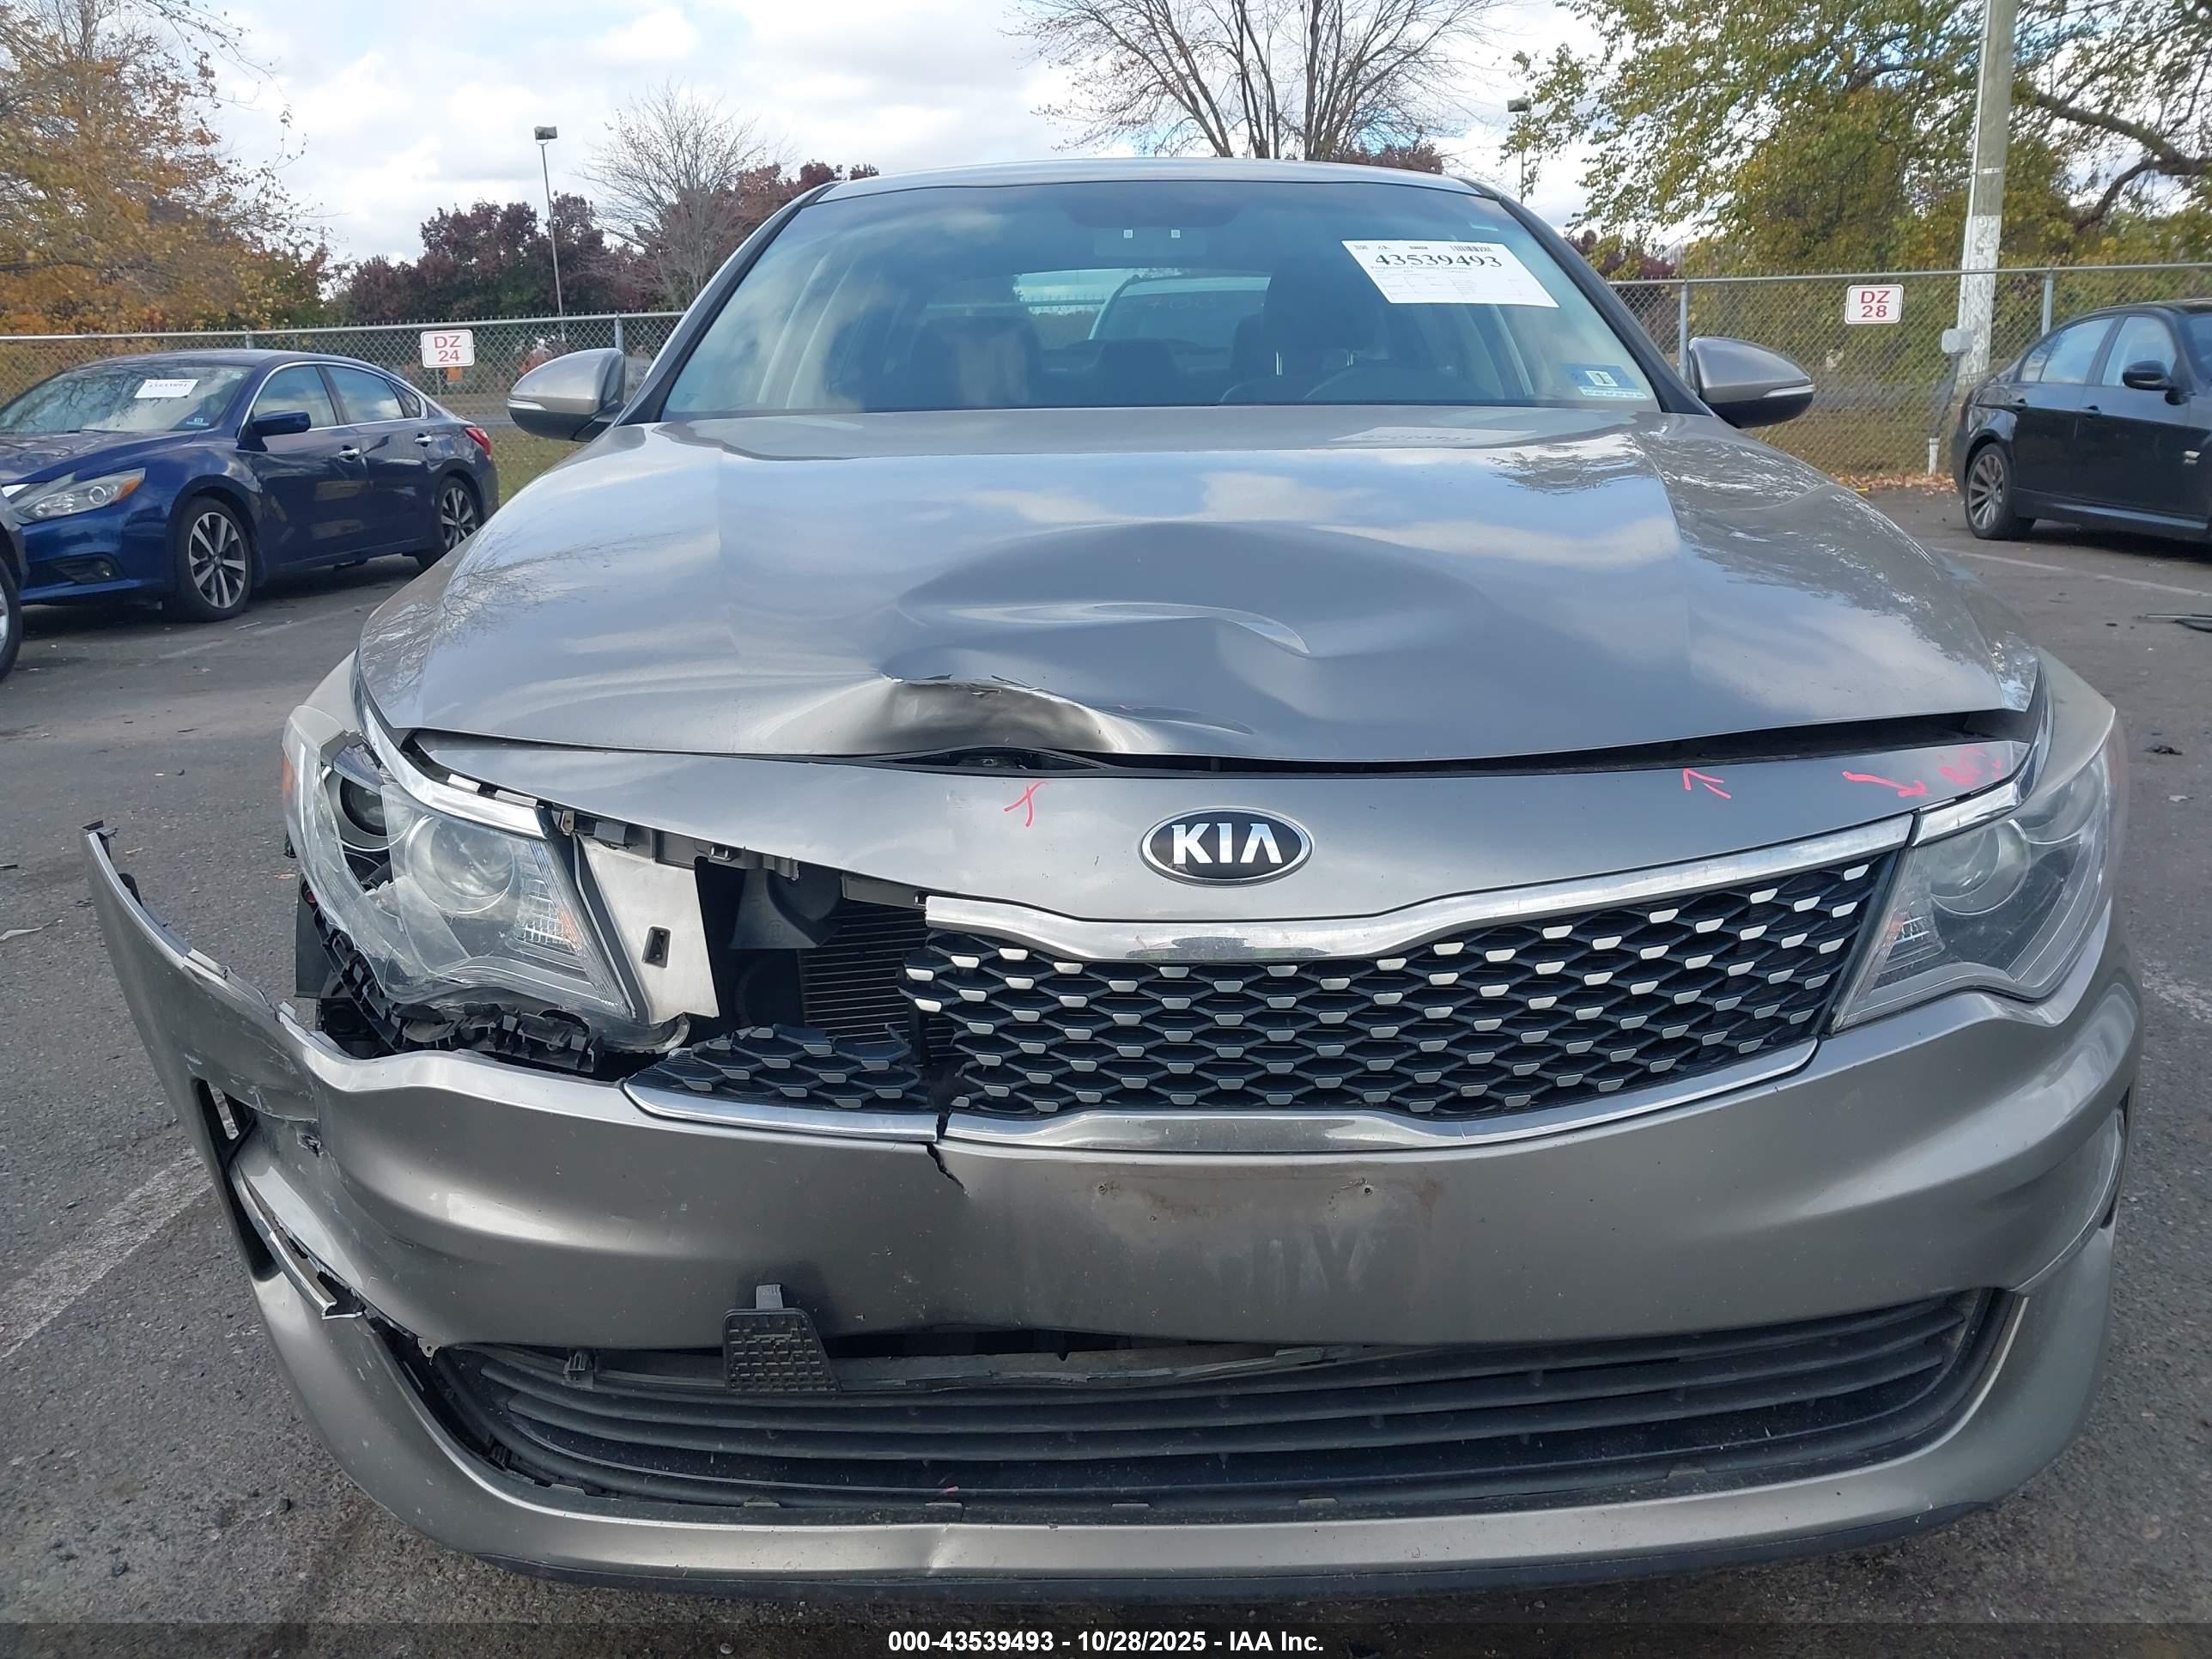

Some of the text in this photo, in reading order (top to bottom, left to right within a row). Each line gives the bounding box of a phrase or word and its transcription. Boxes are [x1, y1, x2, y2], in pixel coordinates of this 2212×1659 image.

[1375, 254, 1502, 267] 43539493
[1861, 290, 1891, 303] DZ
[1862, 305, 1887, 318] 28
[434, 335, 462, 349] DZ
[438, 349, 460, 362] 24
[1171, 823, 1283, 864] KIA
